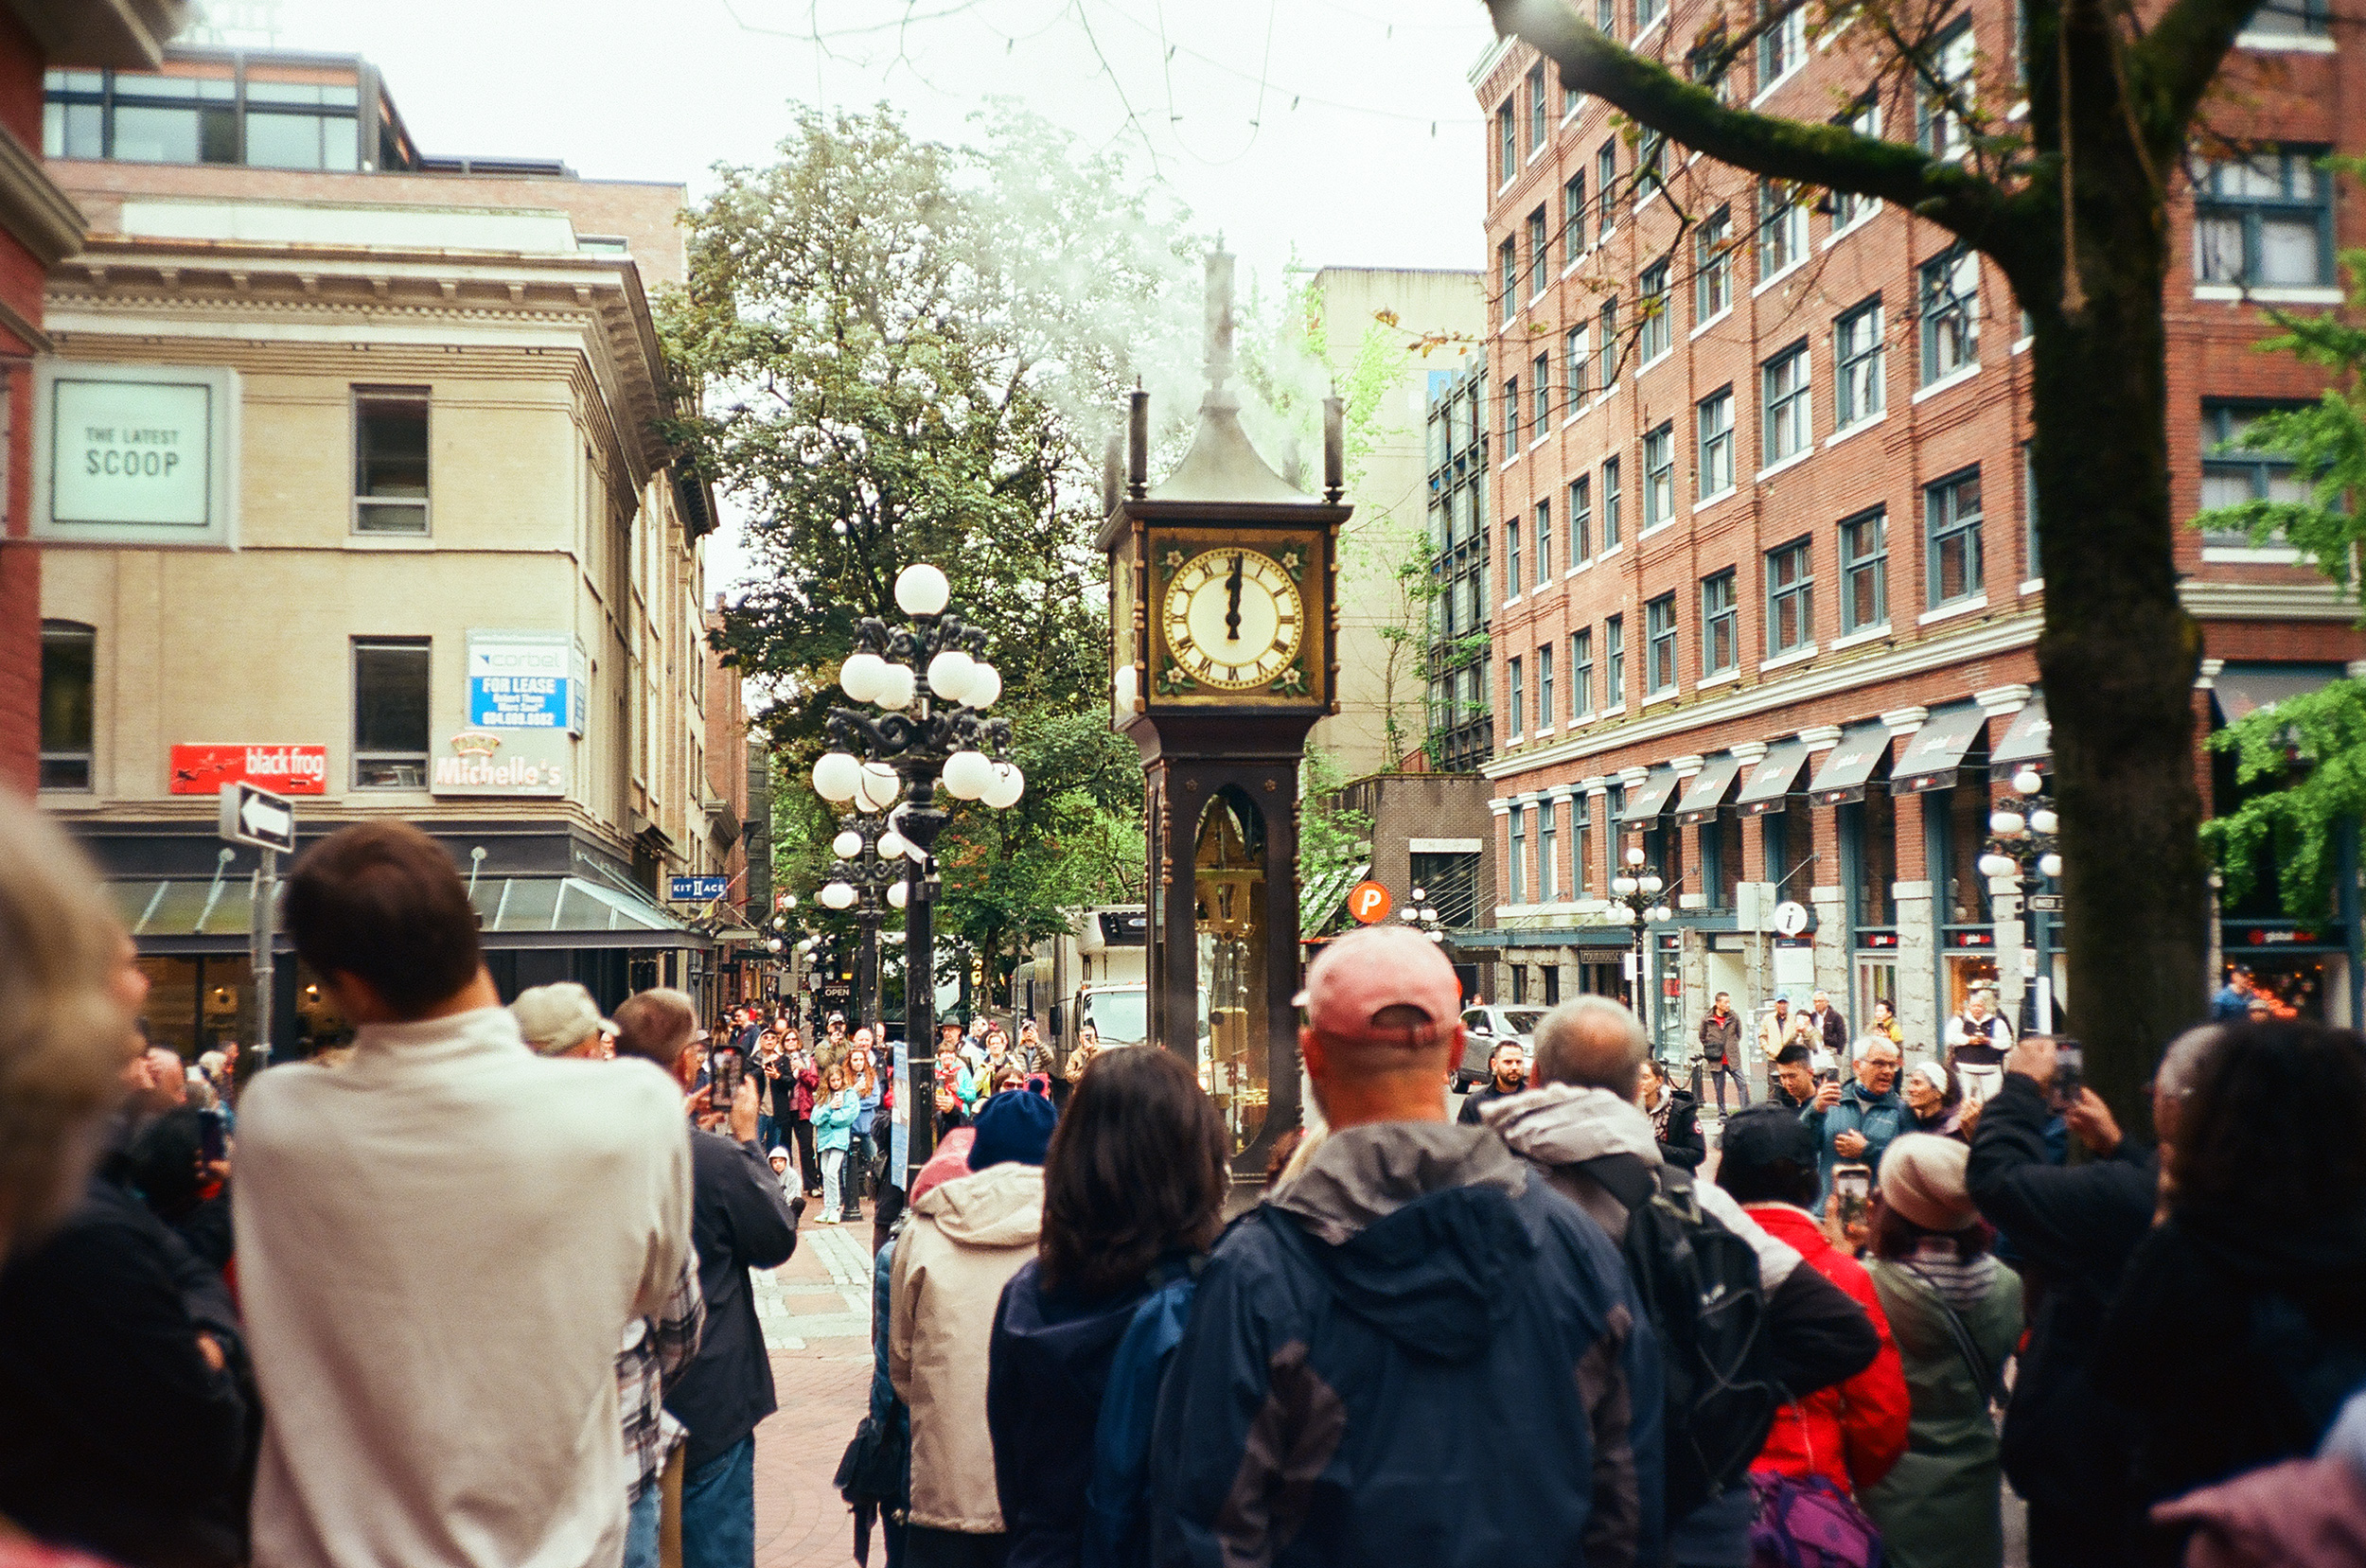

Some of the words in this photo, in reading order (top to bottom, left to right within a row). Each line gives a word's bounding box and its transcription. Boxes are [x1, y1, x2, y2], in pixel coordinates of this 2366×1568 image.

[85, 427, 115, 443] THE
[123, 429, 180, 444] LATEST
[85, 448, 180, 477] SCOOP
[492, 651, 560, 668] corbel
[483, 678, 510, 693] FOR
[512, 678, 556, 694] LEASE
[246, 747, 287, 775] black
[291, 747, 325, 782] frog
[436, 756, 561, 785] Michelle's
[673, 884, 692, 892] KIT
[703, 884, 724, 892] ACE
[1360, 889, 1382, 915] P
[824, 988, 850, 996] OPEN
